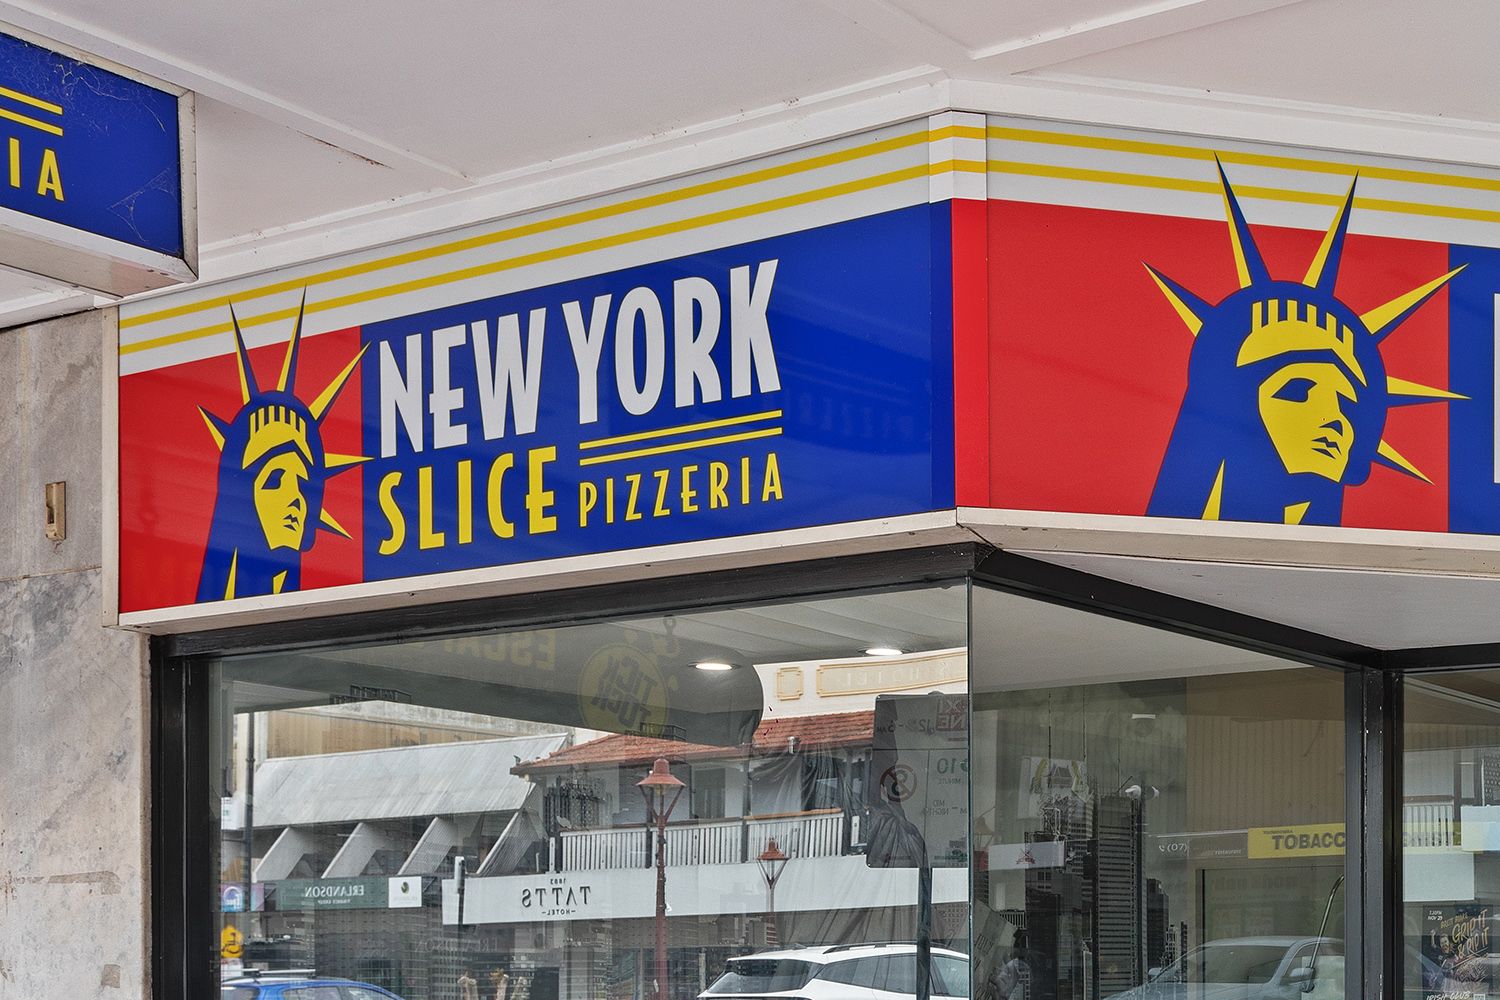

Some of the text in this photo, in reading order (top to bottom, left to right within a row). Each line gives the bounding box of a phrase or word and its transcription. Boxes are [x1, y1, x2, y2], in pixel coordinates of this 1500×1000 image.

[380, 259, 782, 457] NEW YORK
[379, 446, 557, 556] SLICE
[580, 452, 784, 528] PIZZERIA
